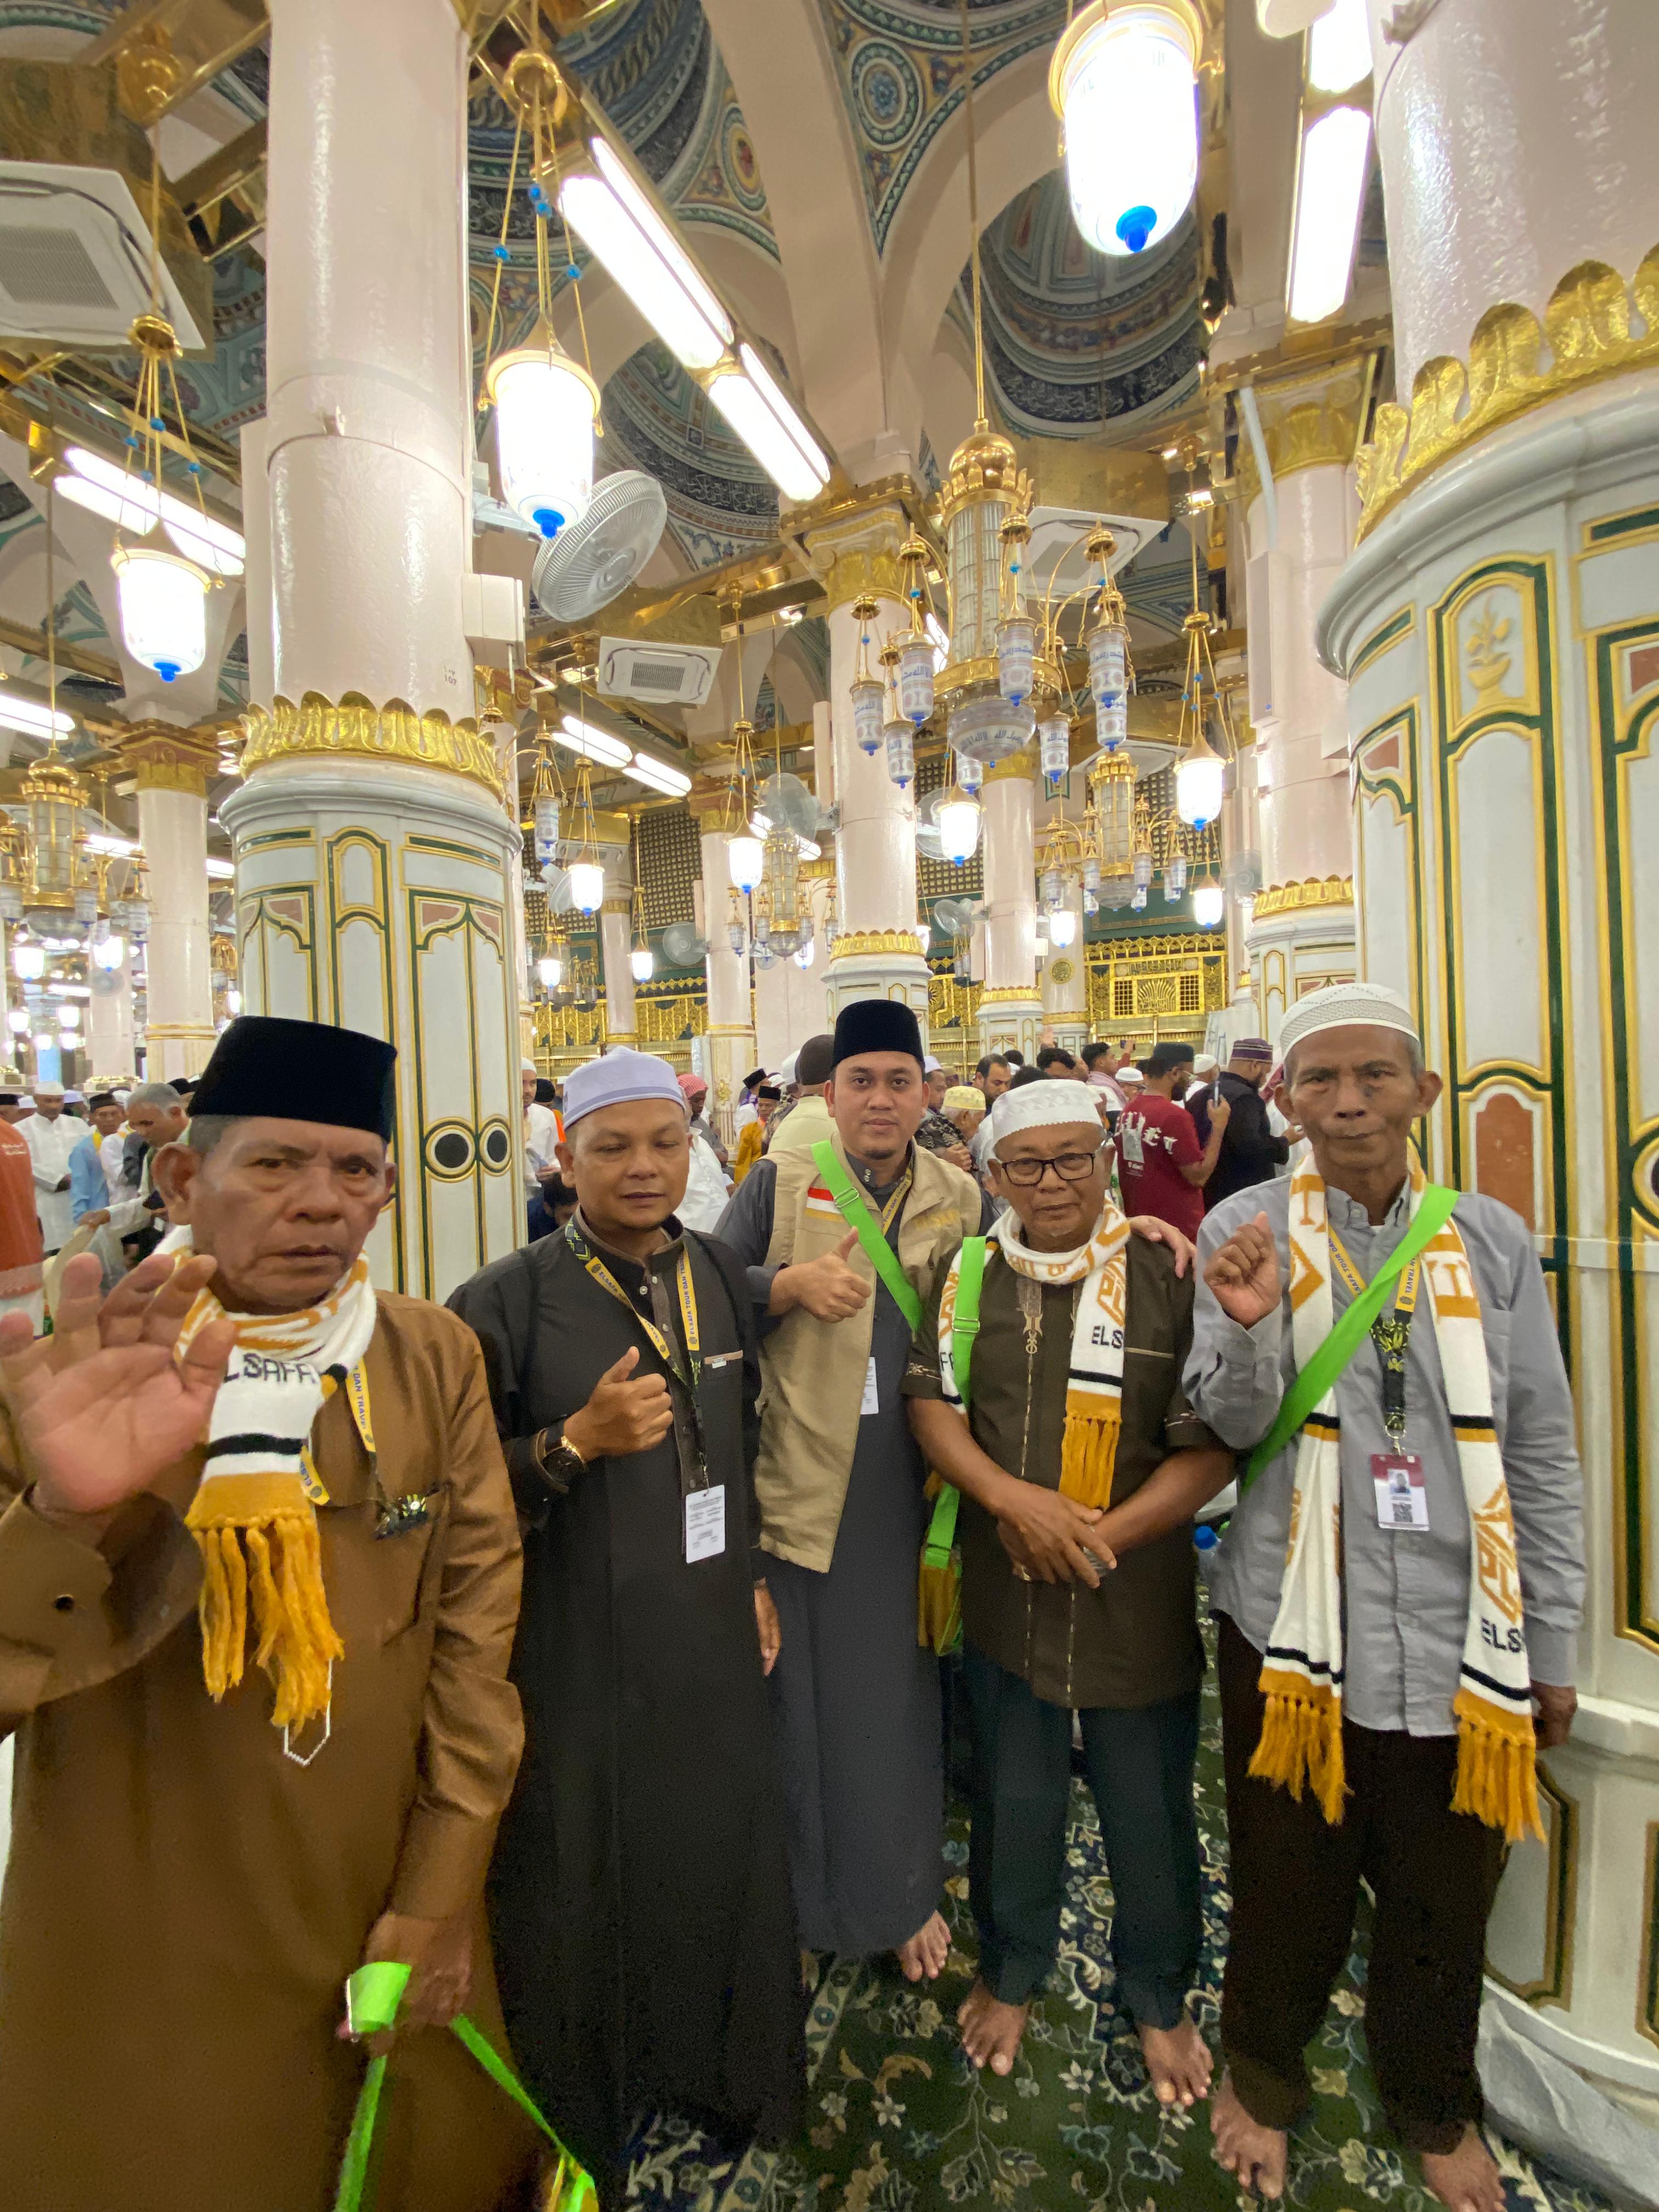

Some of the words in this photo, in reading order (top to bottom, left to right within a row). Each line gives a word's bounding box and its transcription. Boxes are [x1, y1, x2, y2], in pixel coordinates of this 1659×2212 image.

[1335, 1254, 1348, 1273] TOUR
[1404, 1269, 1414, 1294] TRAVEL
[353, 1373, 362, 1392] DAN
